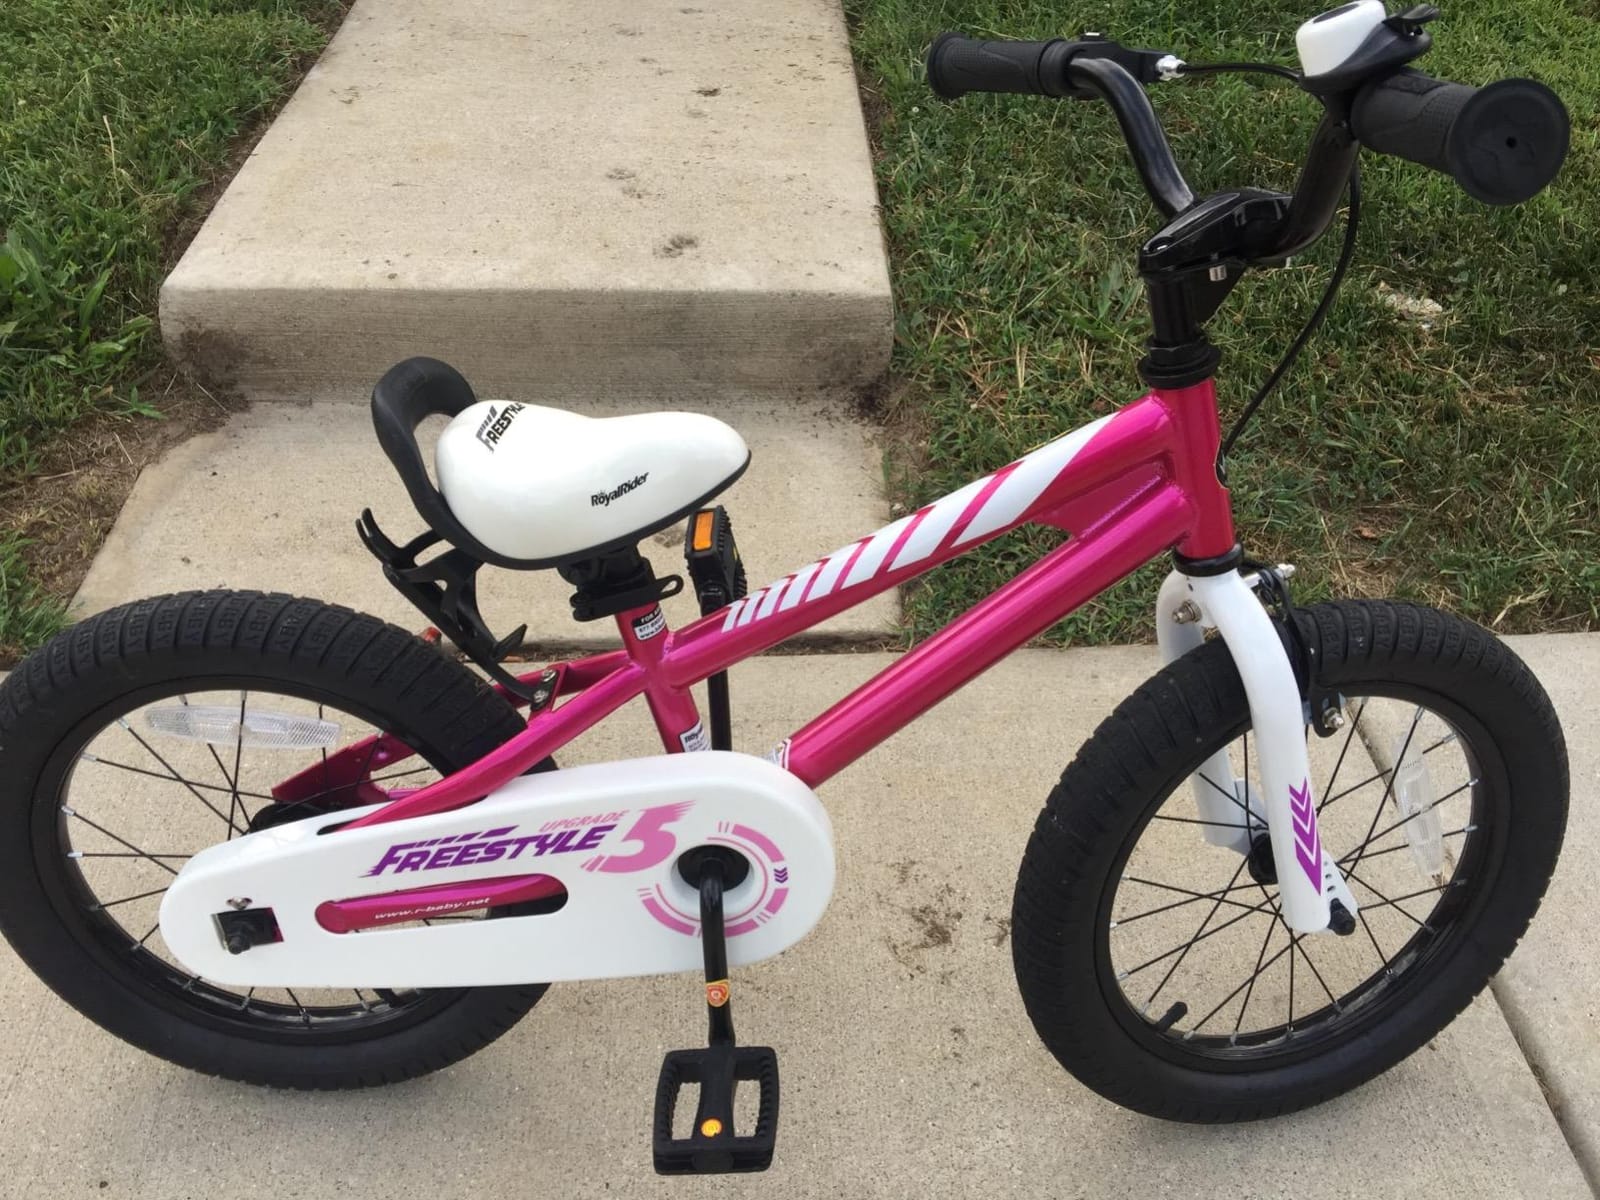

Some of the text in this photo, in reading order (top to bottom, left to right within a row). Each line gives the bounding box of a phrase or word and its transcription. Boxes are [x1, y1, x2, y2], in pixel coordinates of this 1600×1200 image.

[591, 471, 649, 507] RoyalRider
[539, 809, 630, 831] UPGRADE
[359, 823, 617, 878] FREESTYLE
[375, 898, 490, 919] www.r-baby.net
